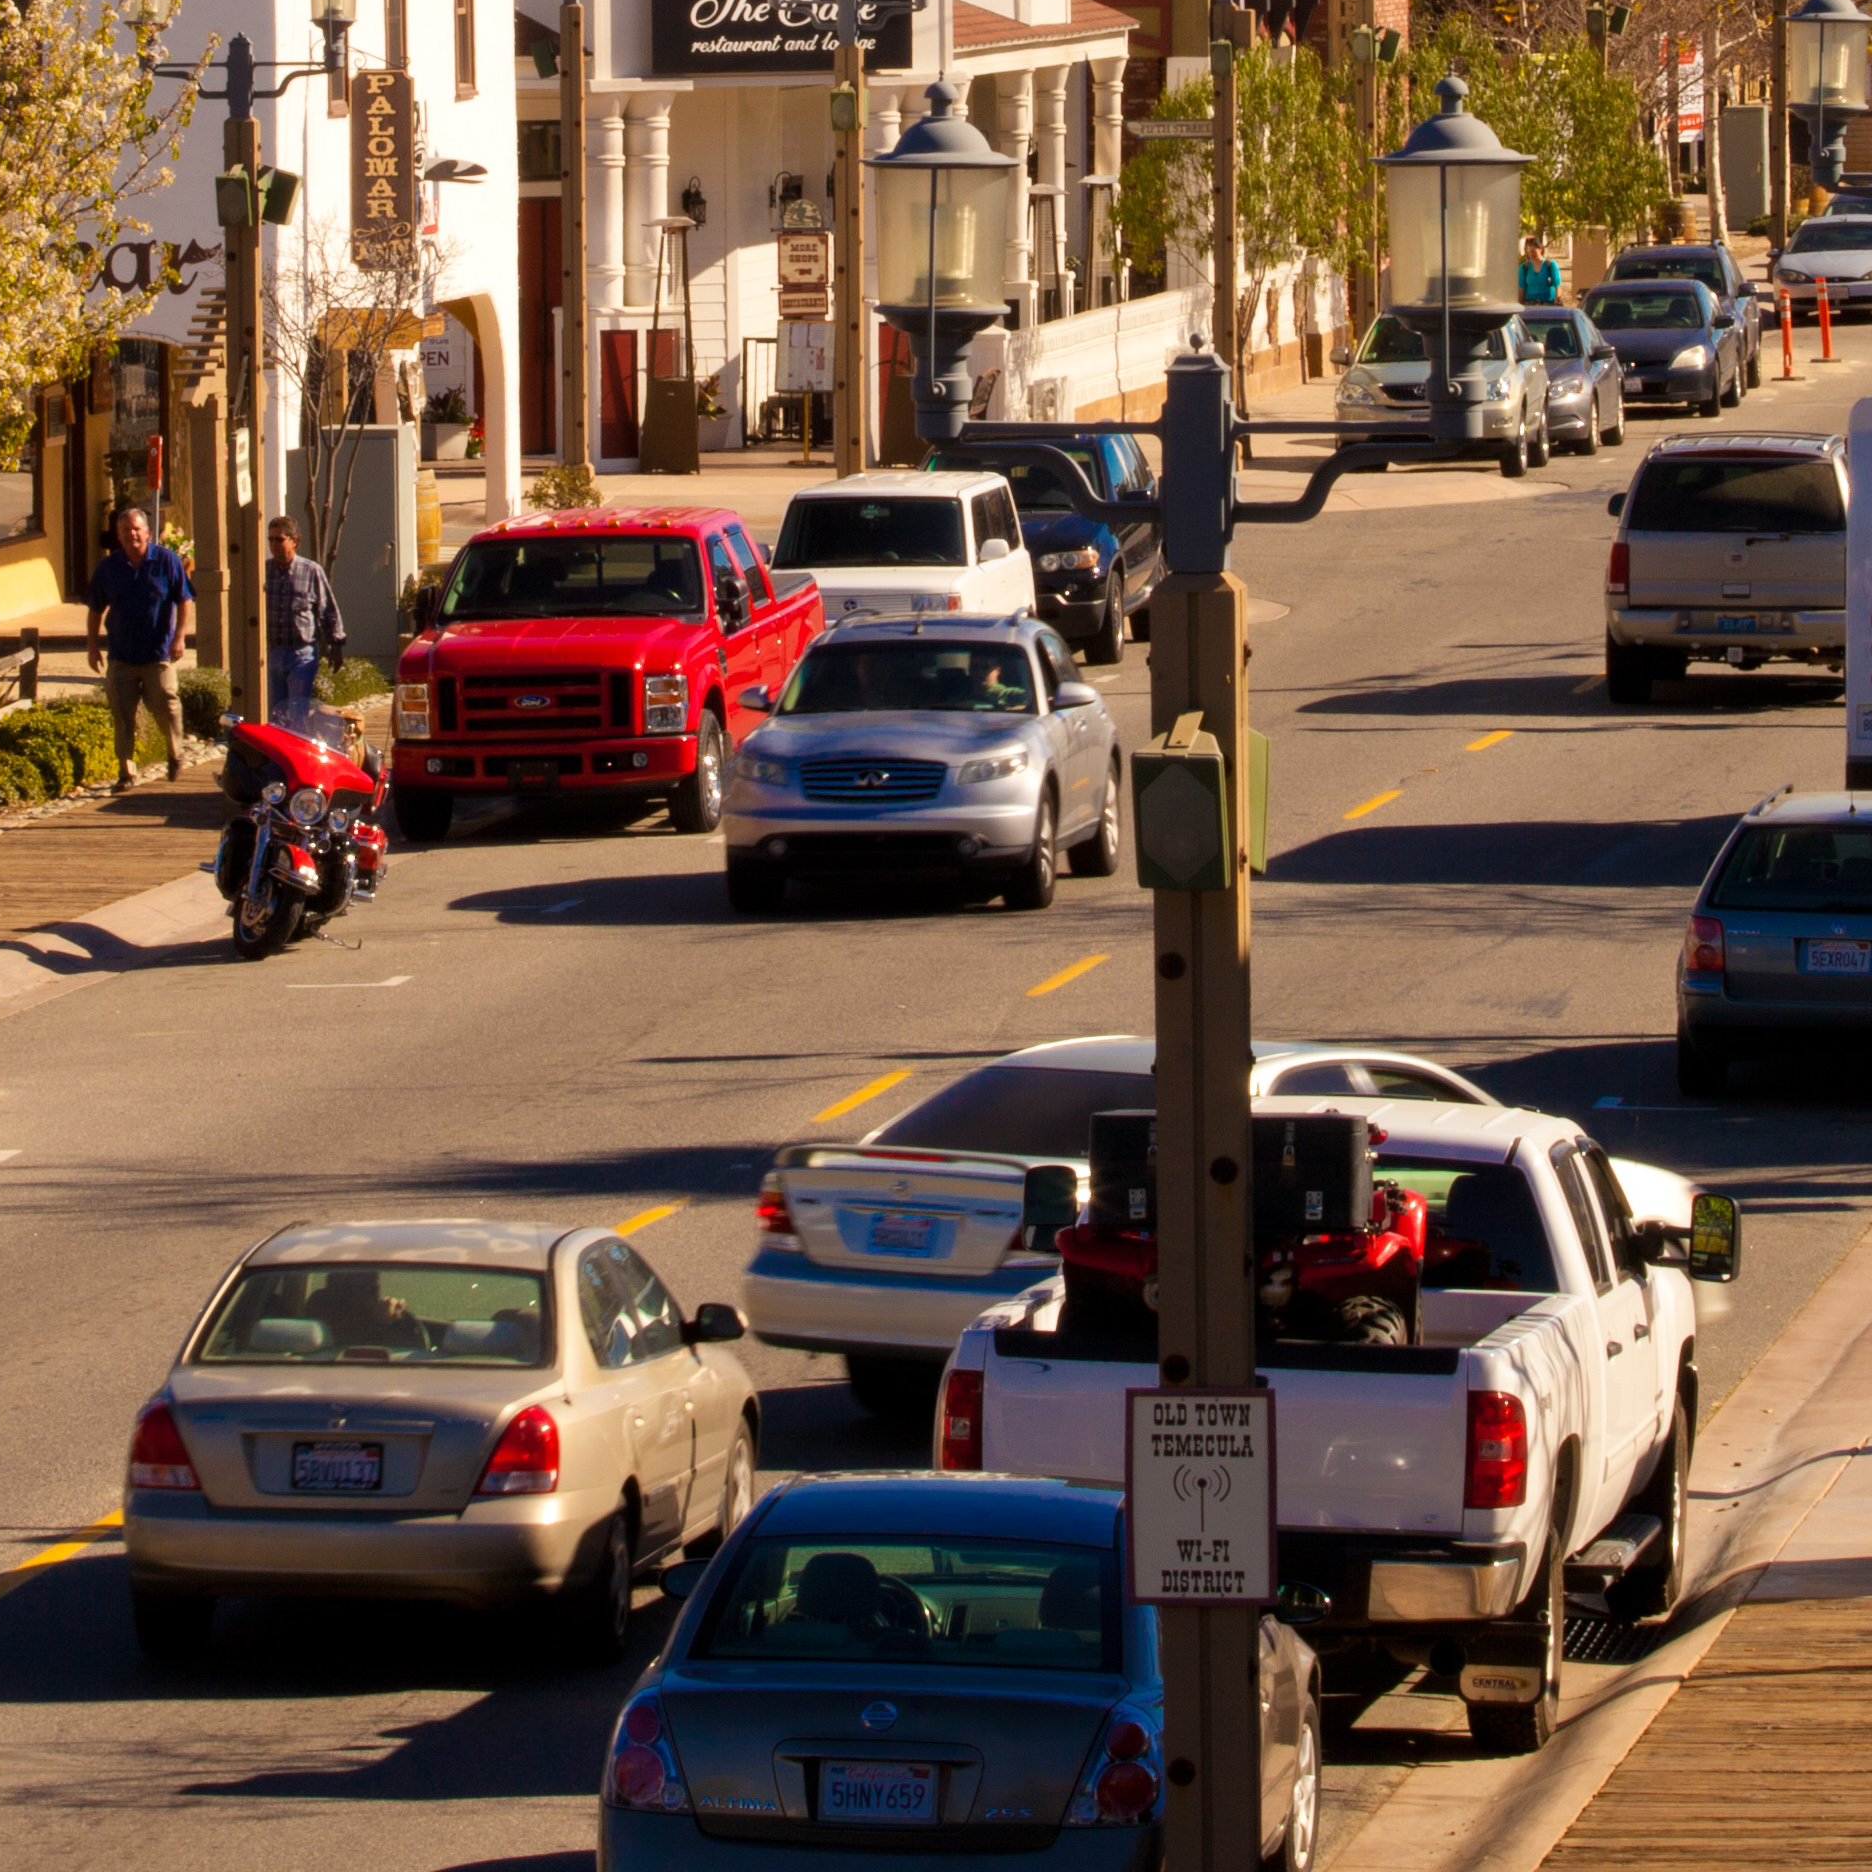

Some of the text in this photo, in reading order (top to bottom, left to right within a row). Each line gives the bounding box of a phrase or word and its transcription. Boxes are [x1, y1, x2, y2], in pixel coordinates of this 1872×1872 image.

[691, 35, 780, 54] restaurant
[784, 33, 815, 52] and
[1140, 124, 1212, 134] FIFTH STREET
[364, 74, 400, 219] PALOMAR
[790, 243, 818, 252] MORE
[789, 254, 819, 263] SHOPS
[420, 350, 450, 367] PEN
[1811, 951, 1867, 967] 5EXR047
[1153, 1403, 1250, 1427] OLD TOWN
[1151, 1434, 1254, 1458] TEMECULA
[1176, 1539, 1230, 1563] WI-FI
[1161, 1570, 1245, 1593] DISTRICT
[1472, 1678, 1517, 1689] CENTRAL
[846, 1767, 910, 1780] California
[699, 1795, 777, 1811] ALTIMA
[831, 1781, 926, 1809] 5HNY659
